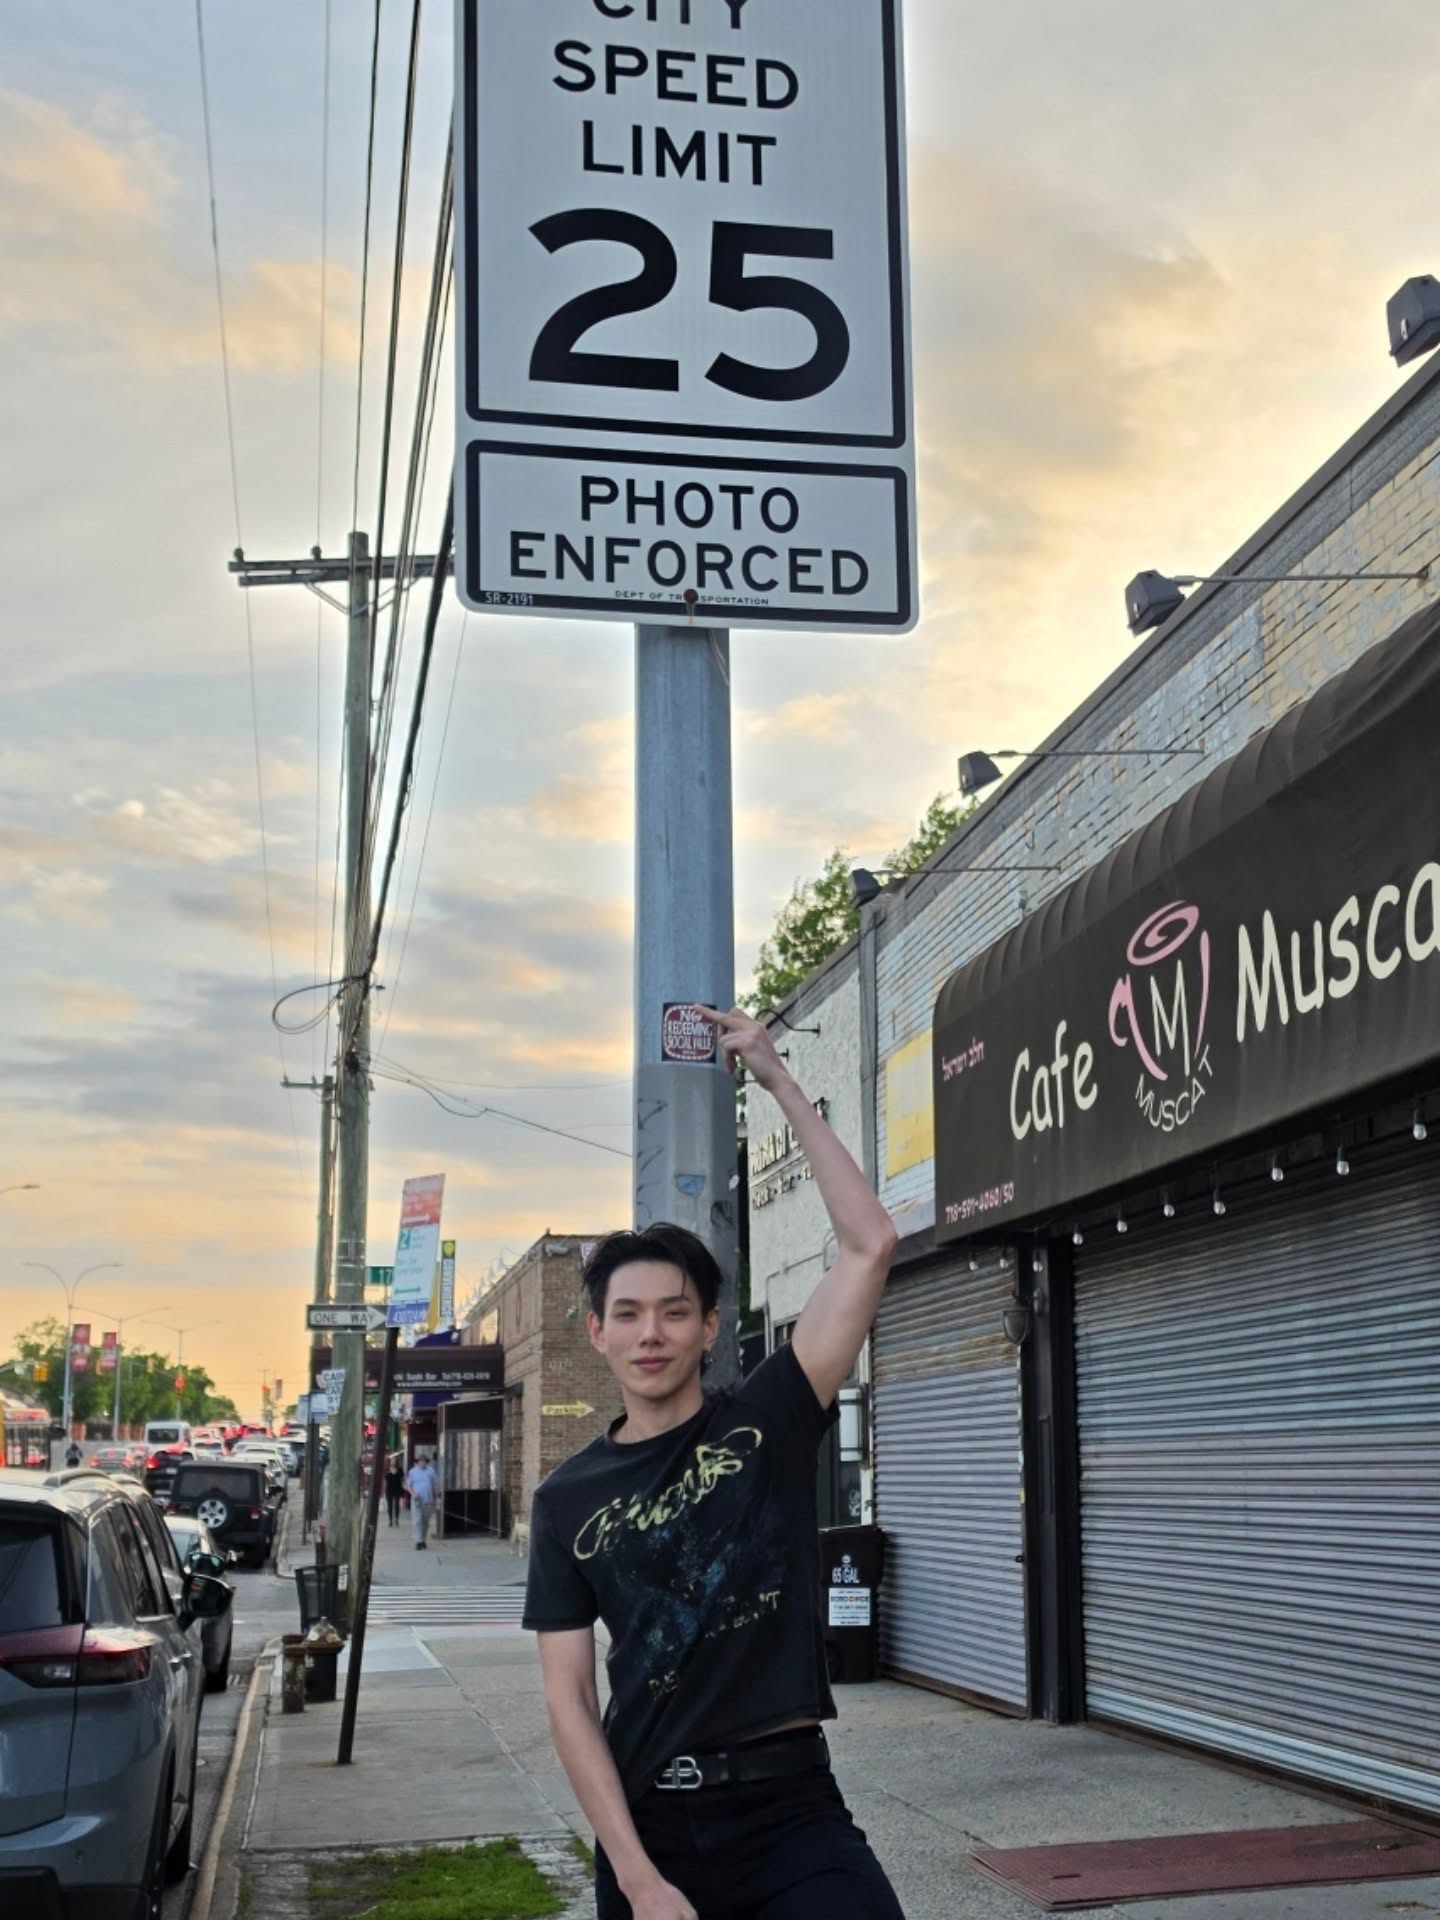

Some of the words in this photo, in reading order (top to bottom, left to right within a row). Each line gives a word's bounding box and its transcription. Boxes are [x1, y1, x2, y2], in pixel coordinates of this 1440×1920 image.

[552, 40, 799, 109] SPEED
[582, 120, 777, 186] LIMIT
[528, 208, 850, 402] 25
[580, 475, 799, 533] PHOTO
[510, 530, 869, 596] ENFORCED
[485, 591, 533, 606] SR-2191
[615, 590, 644, 600] DEPT
[649, 592, 665, 600] OF
[670, 593, 769, 606] TRSPORTATION
[1010, 1019, 1097, 1140] Cafe
[1135, 1044, 1213, 1132] MUSCAT
[313, 1312, 338, 1325] ONE
[351, 1312, 376, 1325] WAY
[832, 1567, 842, 1584] 65
